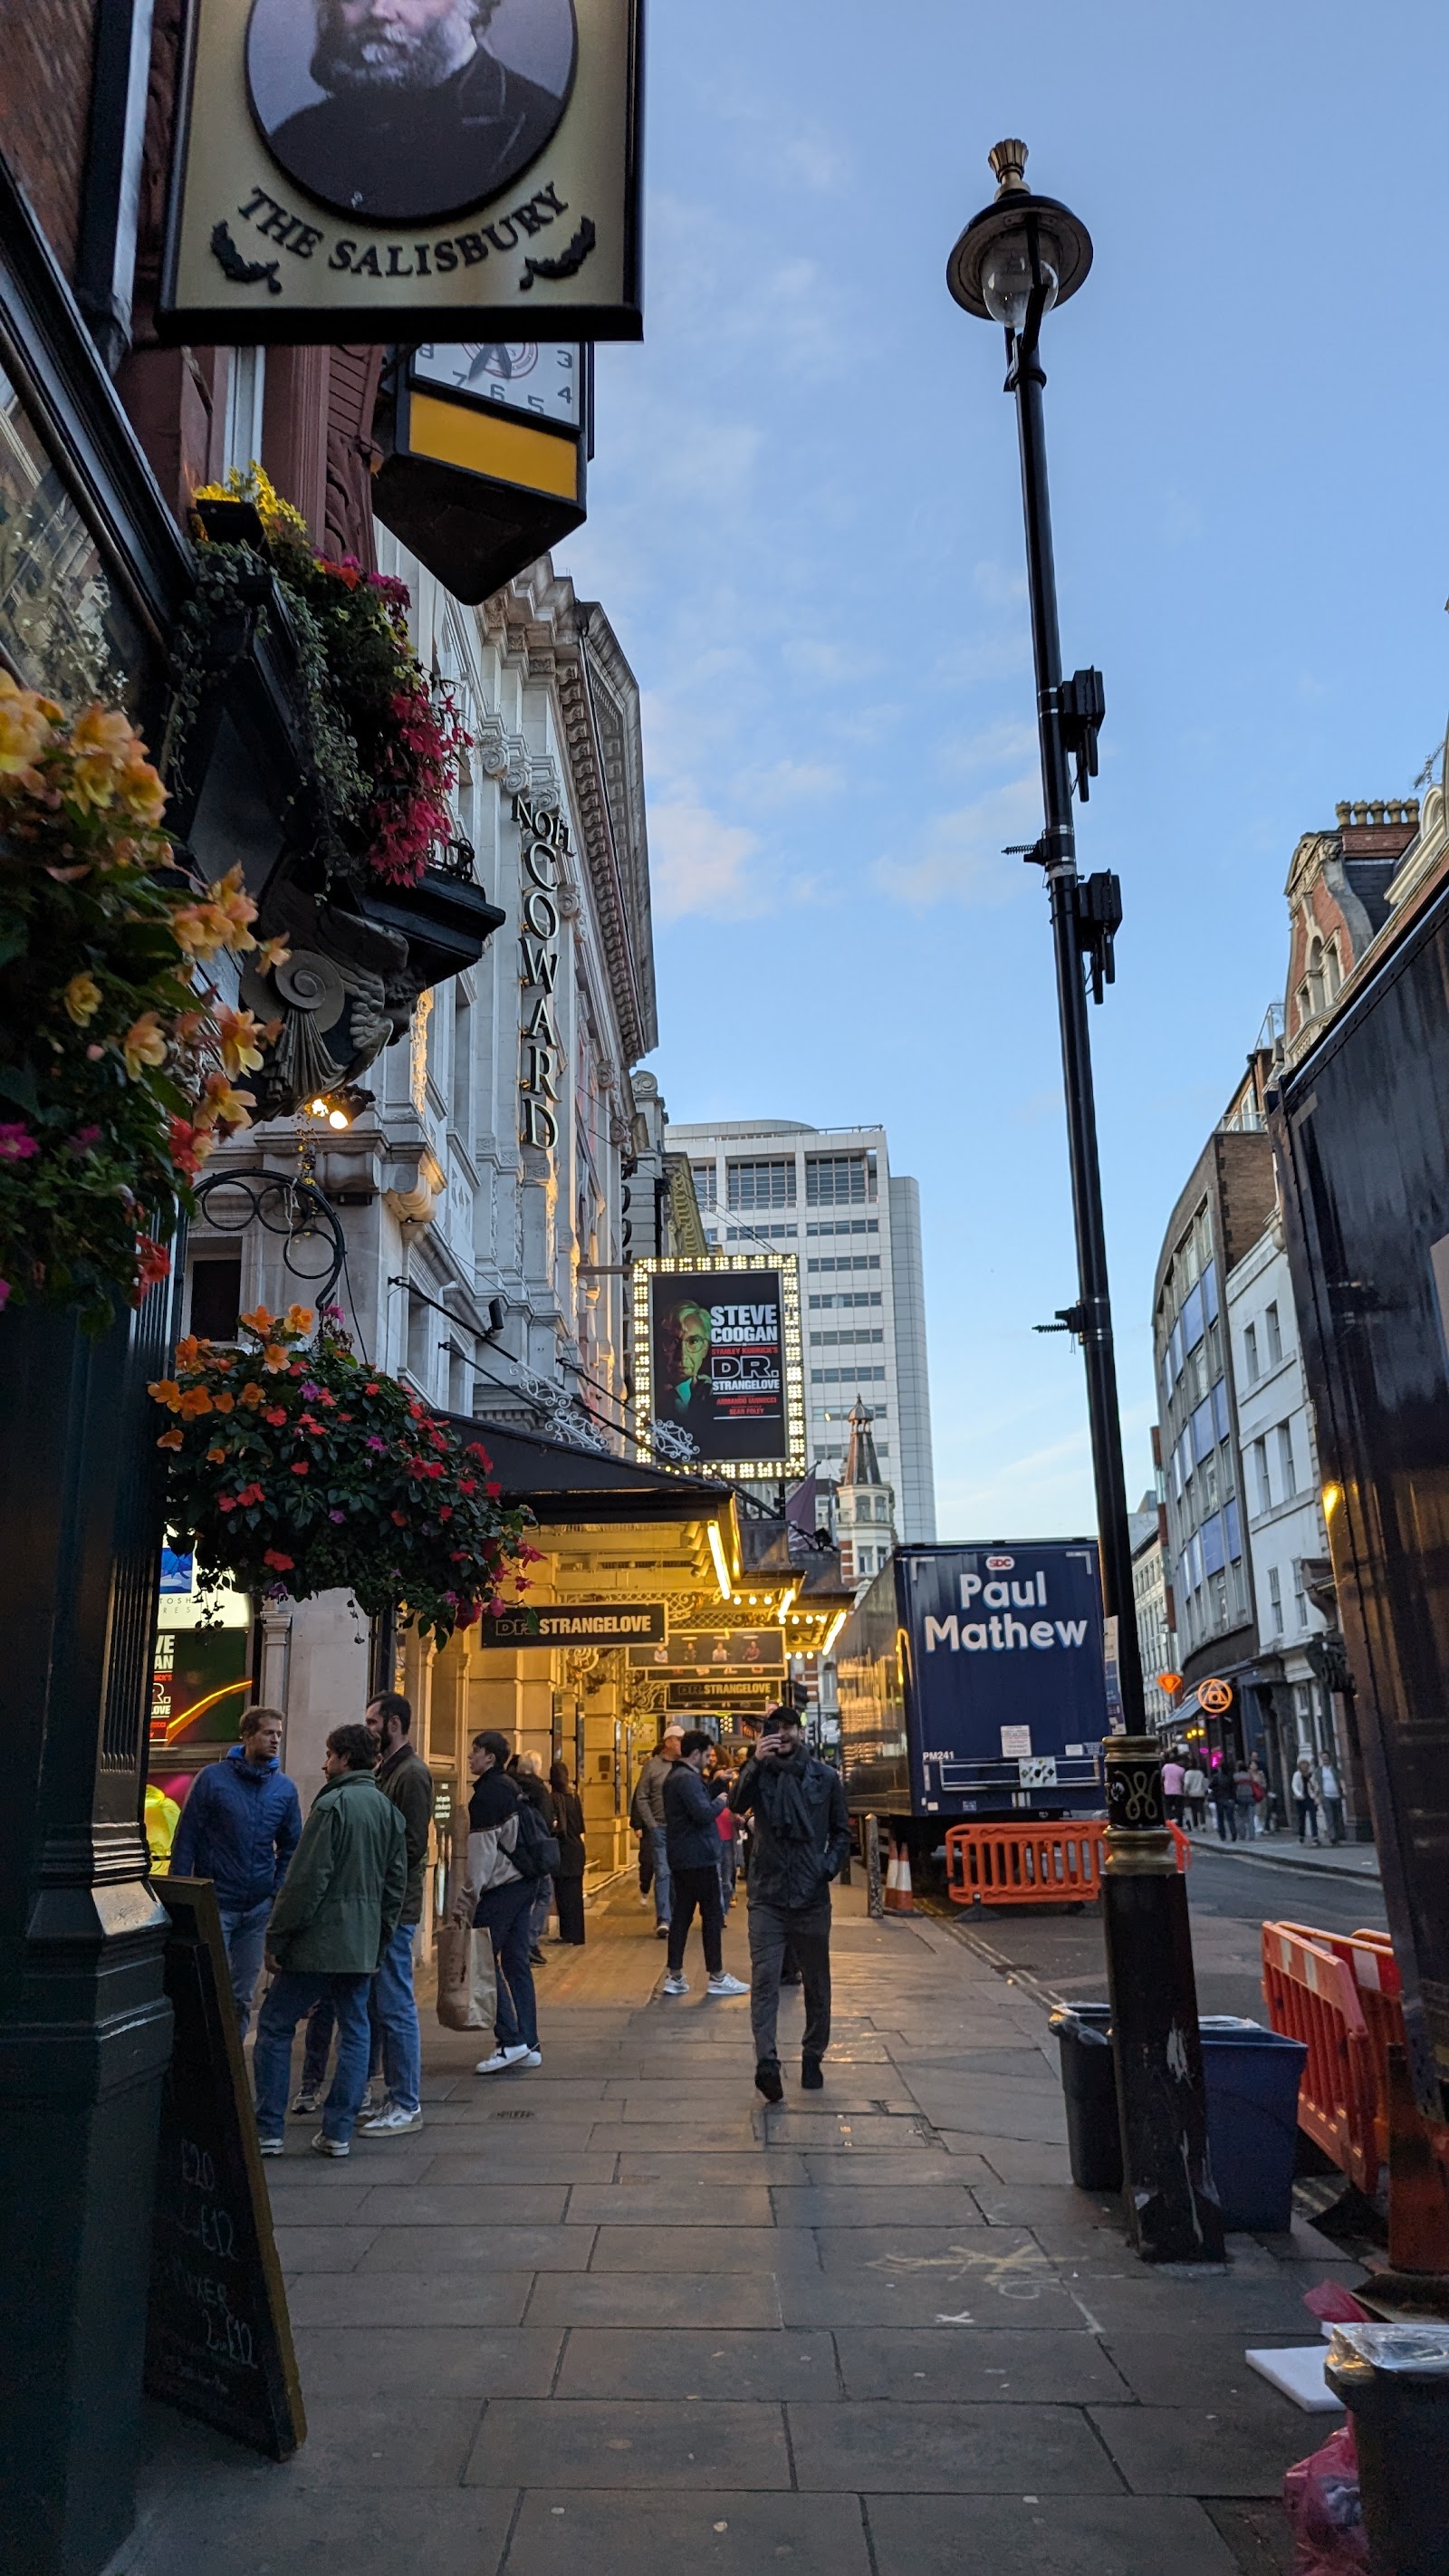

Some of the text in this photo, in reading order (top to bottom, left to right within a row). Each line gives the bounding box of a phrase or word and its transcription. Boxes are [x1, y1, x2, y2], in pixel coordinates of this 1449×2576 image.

[237, 181, 569, 277] THE SALISBURY
[557, 350, 572, 369] 3
[557, 387, 572, 404] 4
[517, 841, 561, 1150] COWARD
[711, 1304, 777, 1326] STEVE
[711, 1326, 778, 1343] COOGAN
[712, 1355, 780, 1380] DR.
[713, 1379, 780, 1391] STRANGELOVE
[988, 1558, 1012, 1568] SDC
[960, 1571, 1047, 1611] Paul
[539, 1615, 651, 1635] STRANGELOVE
[924, 1613, 1088, 1653] Mathew
[704, 1683, 772, 1695] STRANGELOVE
[923, 1751, 955, 1761] PM241
